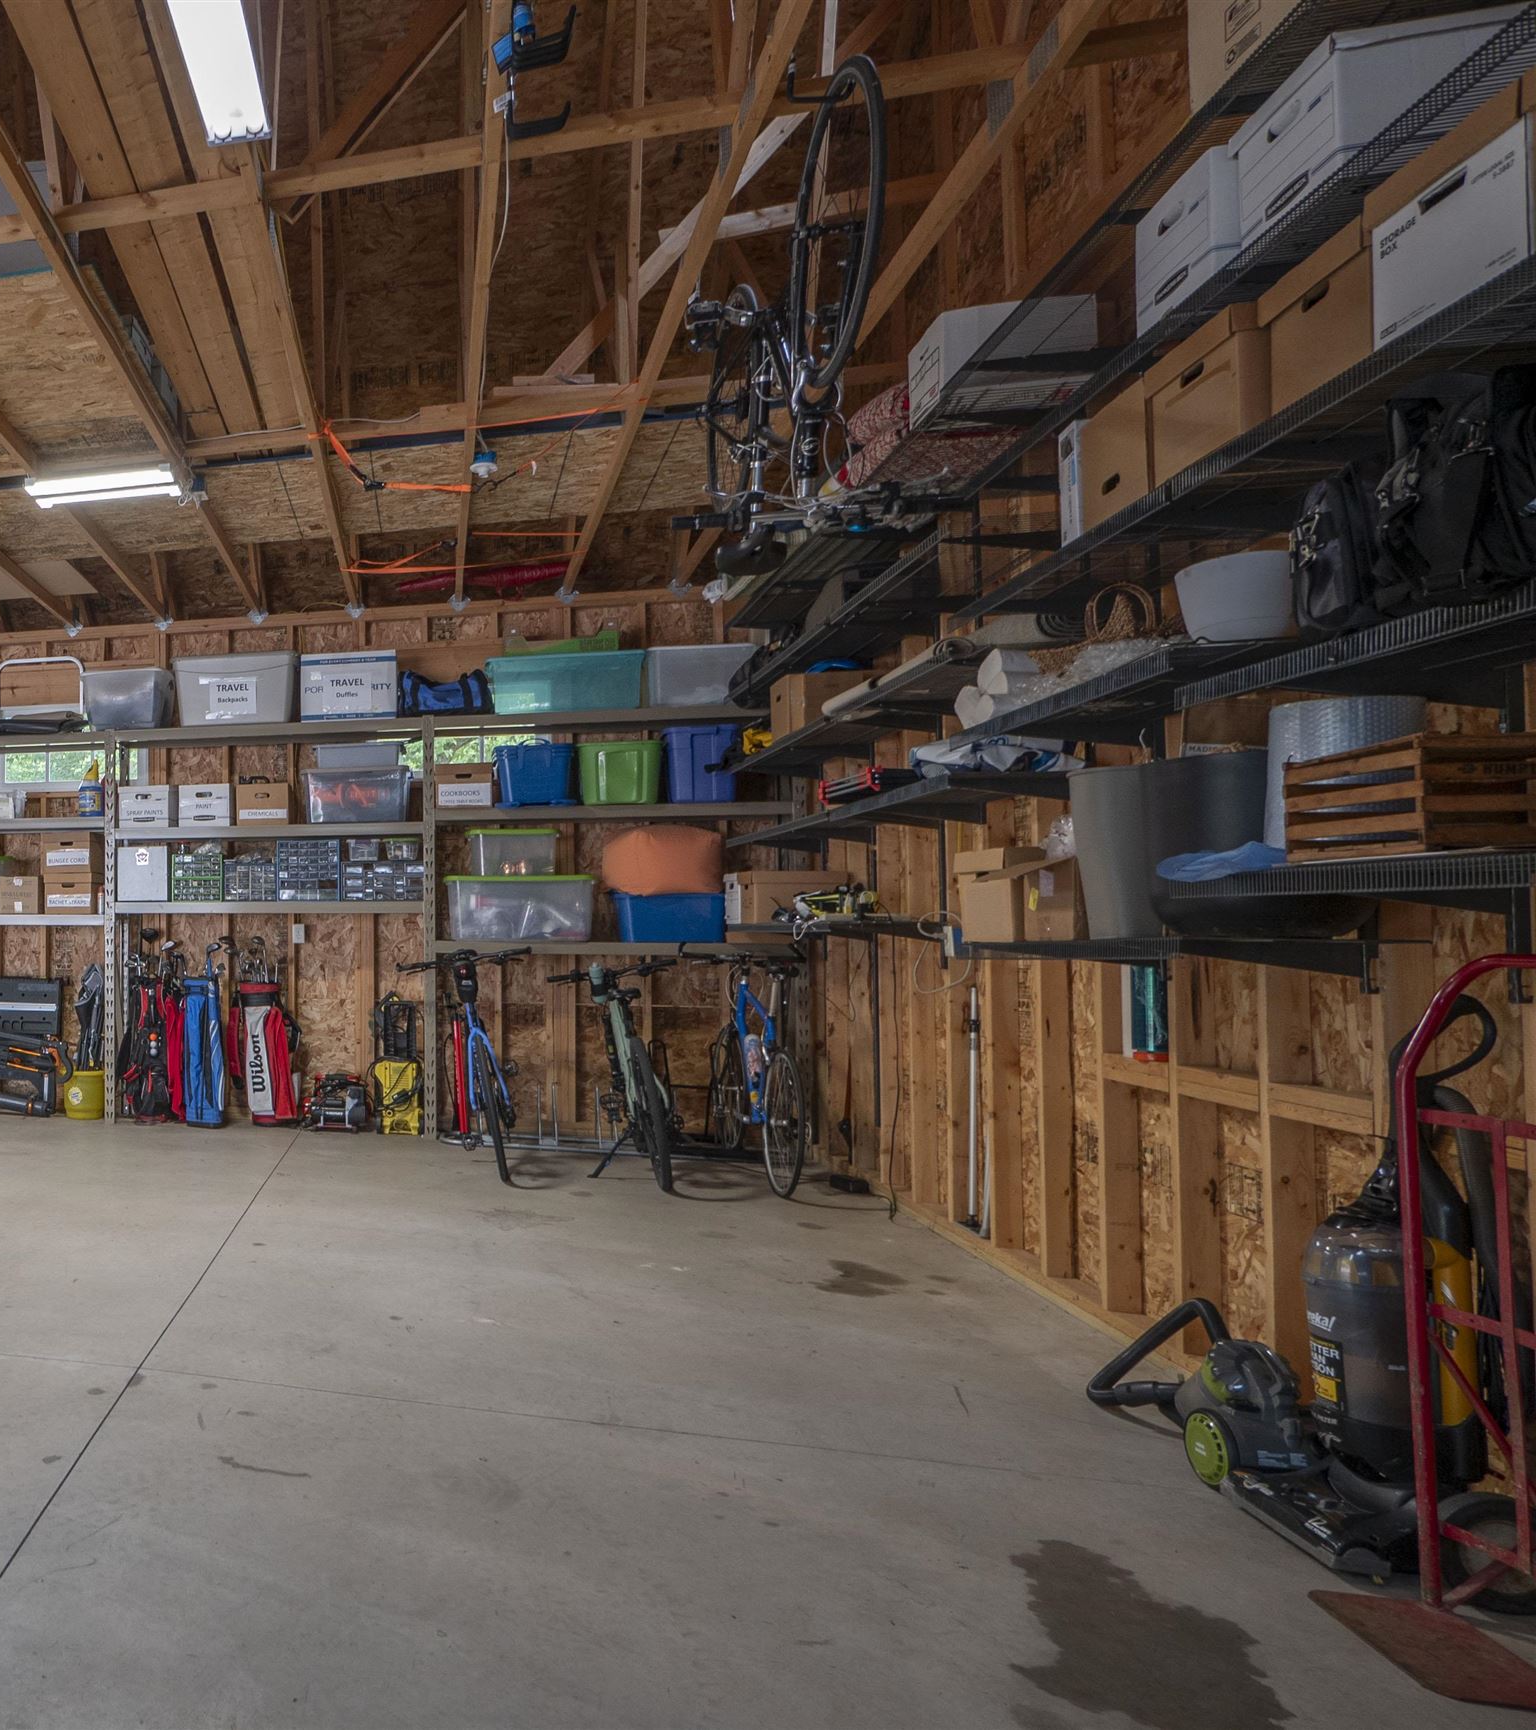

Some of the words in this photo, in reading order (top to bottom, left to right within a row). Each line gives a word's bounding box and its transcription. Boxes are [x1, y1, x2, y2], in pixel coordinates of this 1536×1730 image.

[1380, 216, 1416, 249] STORAGE
[1380, 240, 1397, 259] BOX
[216, 683, 249, 692] TRAVEL
[330, 678, 365, 687] TRAVEL
[217, 696, 248, 704] Backpacks
[249, 1034, 266, 1094] Wilson
